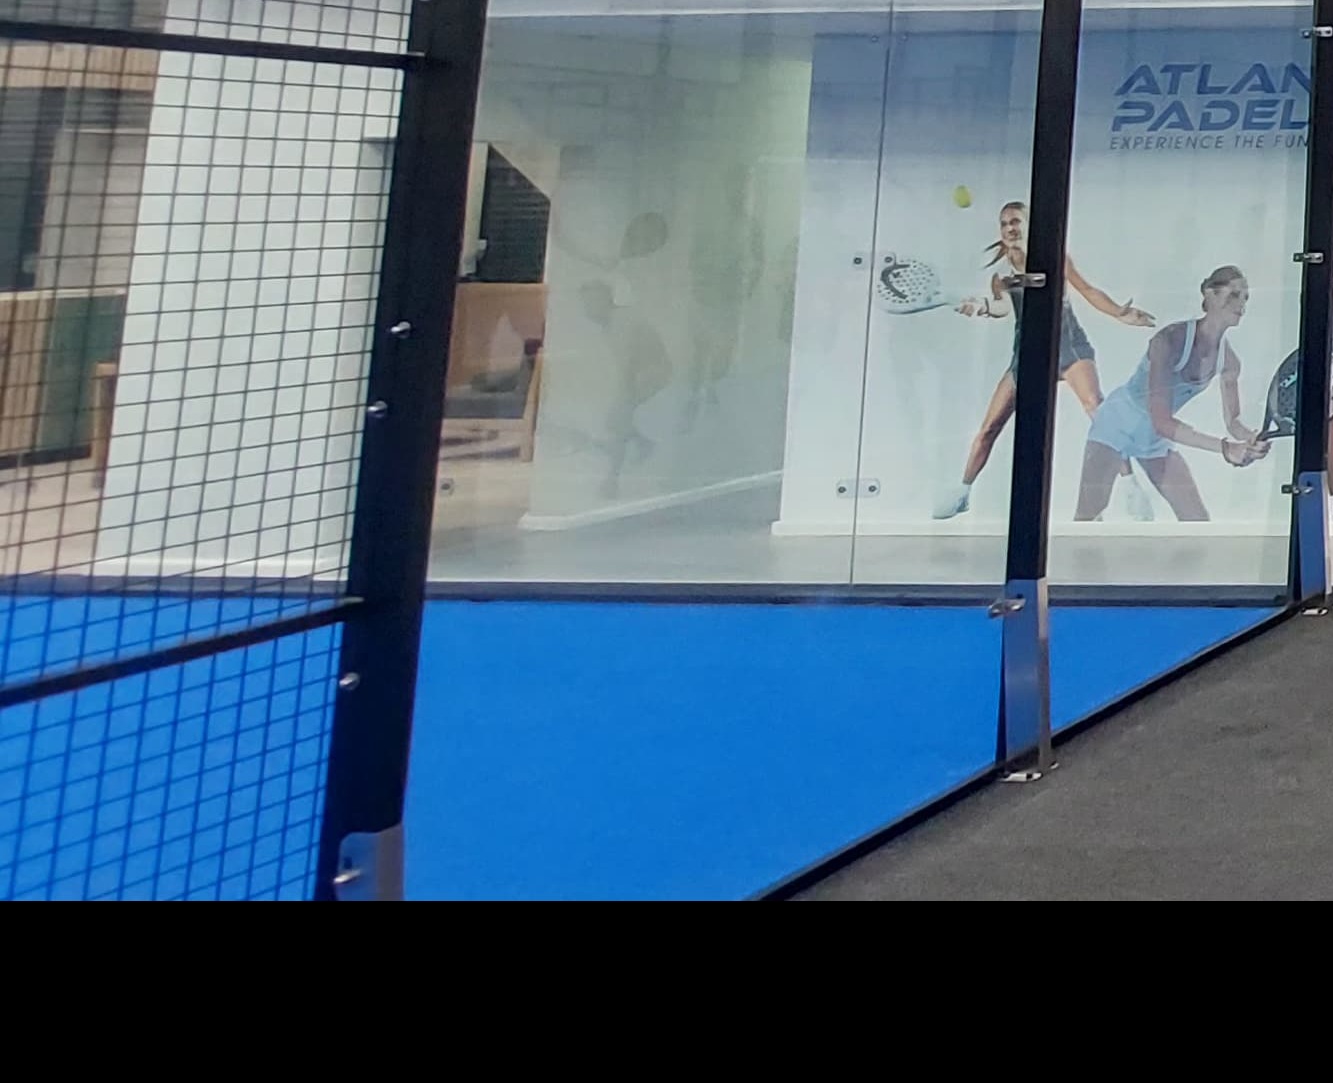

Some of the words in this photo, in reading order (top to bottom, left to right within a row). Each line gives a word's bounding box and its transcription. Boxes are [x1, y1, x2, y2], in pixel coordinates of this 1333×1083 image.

[1111, 99, 1309, 132] PADEL
[1110, 135, 1224, 150] EXPERIENCE
[1234, 134, 1264, 149] THE
[1273, 134, 1310, 149] FUN
